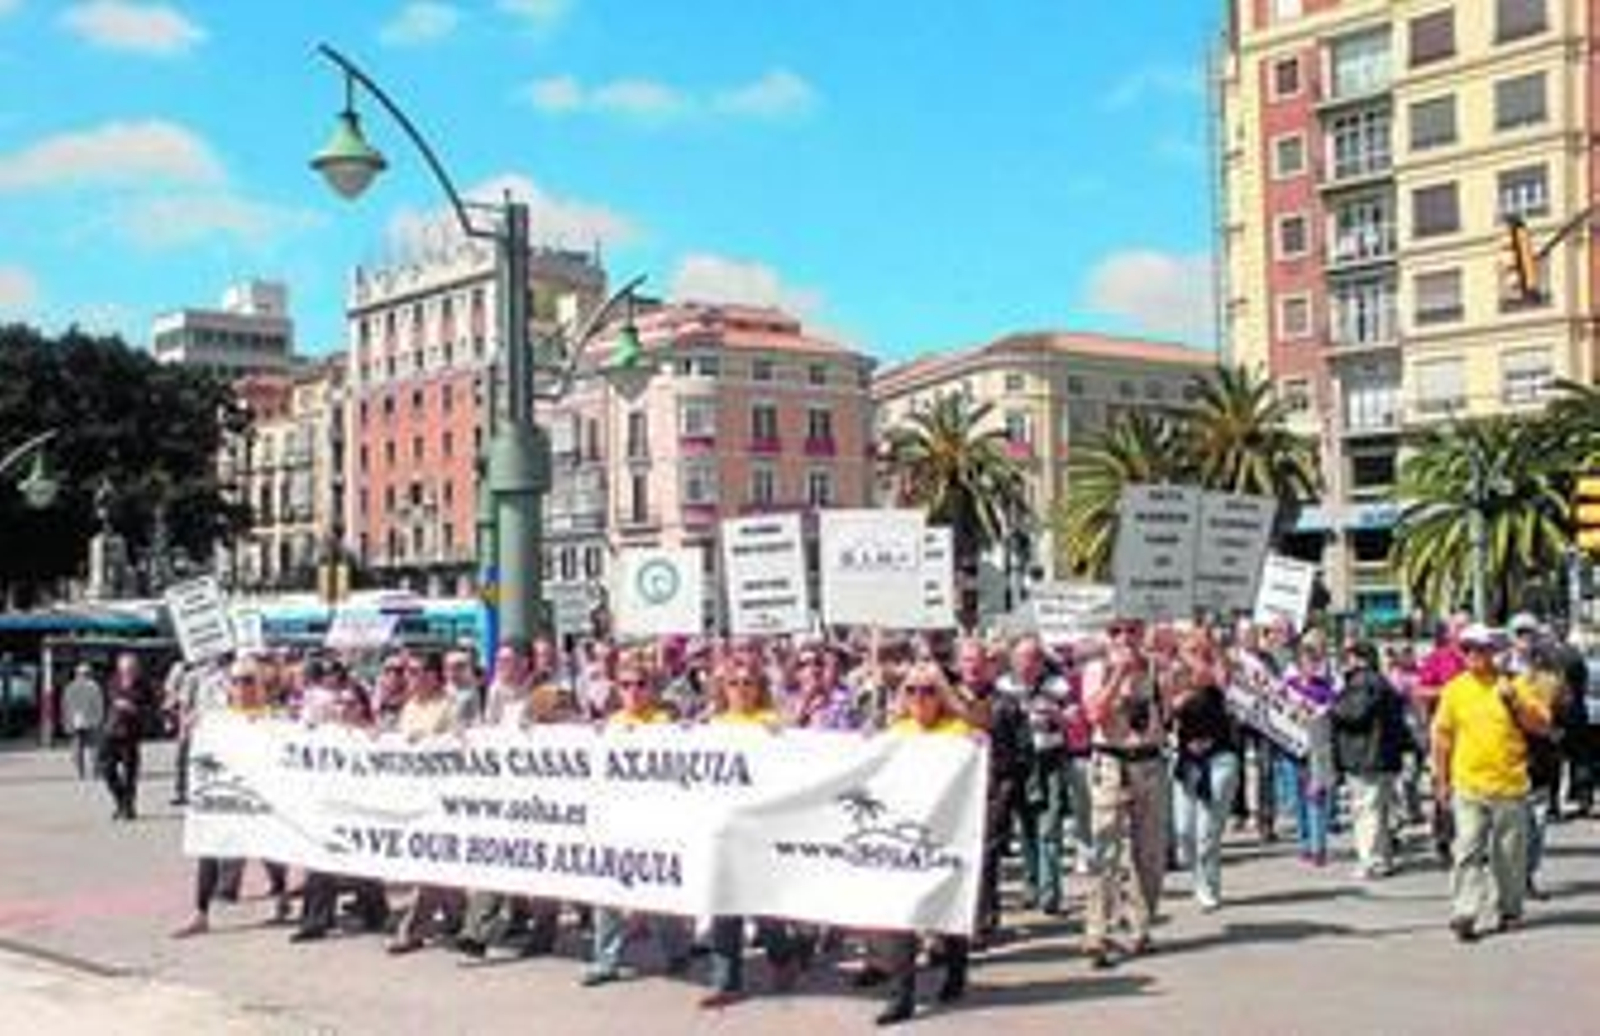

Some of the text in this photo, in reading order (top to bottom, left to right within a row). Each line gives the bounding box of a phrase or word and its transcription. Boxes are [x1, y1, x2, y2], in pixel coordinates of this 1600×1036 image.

[506, 747, 591, 778] CASAS
[408, 832, 460, 862] OUR
[465, 836, 548, 872] HOMES
